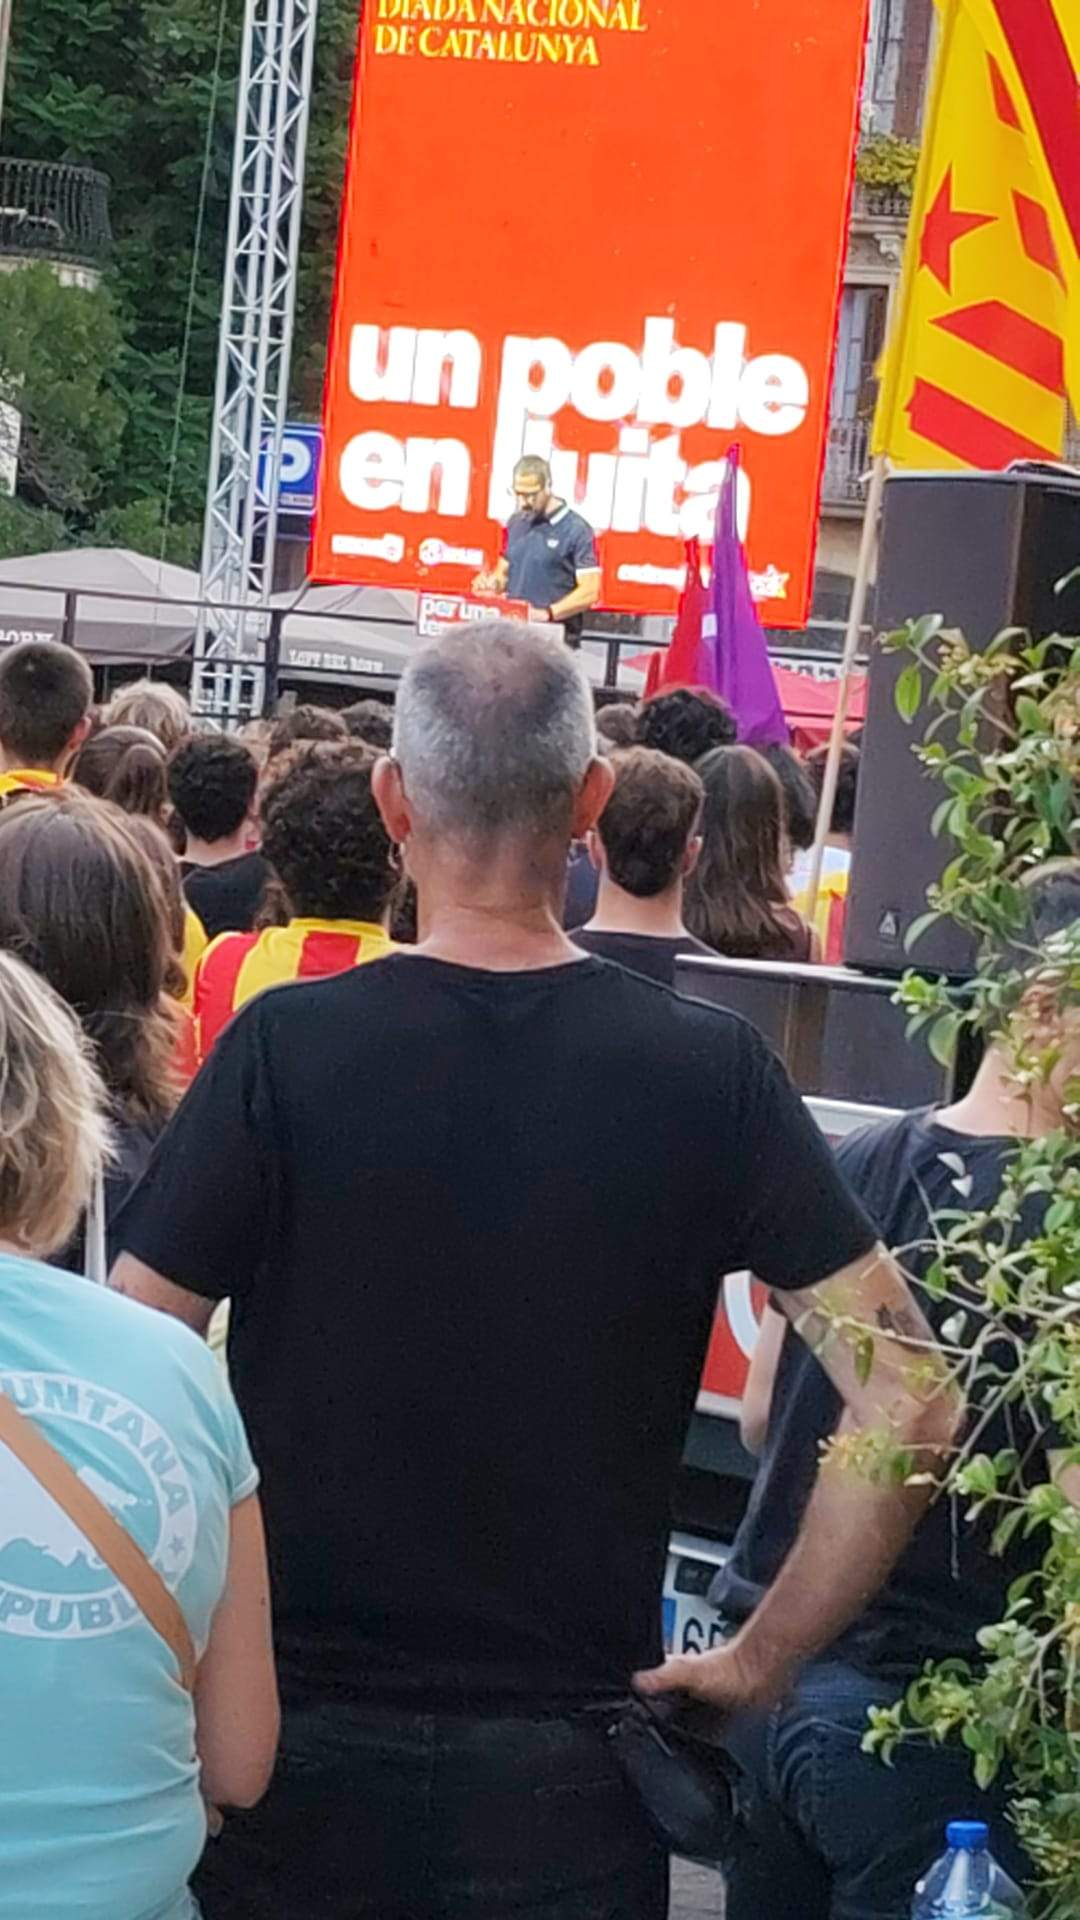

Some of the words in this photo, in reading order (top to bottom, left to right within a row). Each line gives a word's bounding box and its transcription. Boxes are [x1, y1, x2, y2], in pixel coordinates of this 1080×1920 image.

[378, 0, 477, 23] DIADA
[480, 0, 648, 31] NACIONAL
[374, 24, 416, 56] DE
[418, 26, 600, 66] CATALUNYA
[348, 323, 481, 409] un
[488, 316, 809, 522] poble
[339, 430, 471, 517] en
[0, 1584, 138, 1632] PUBL
